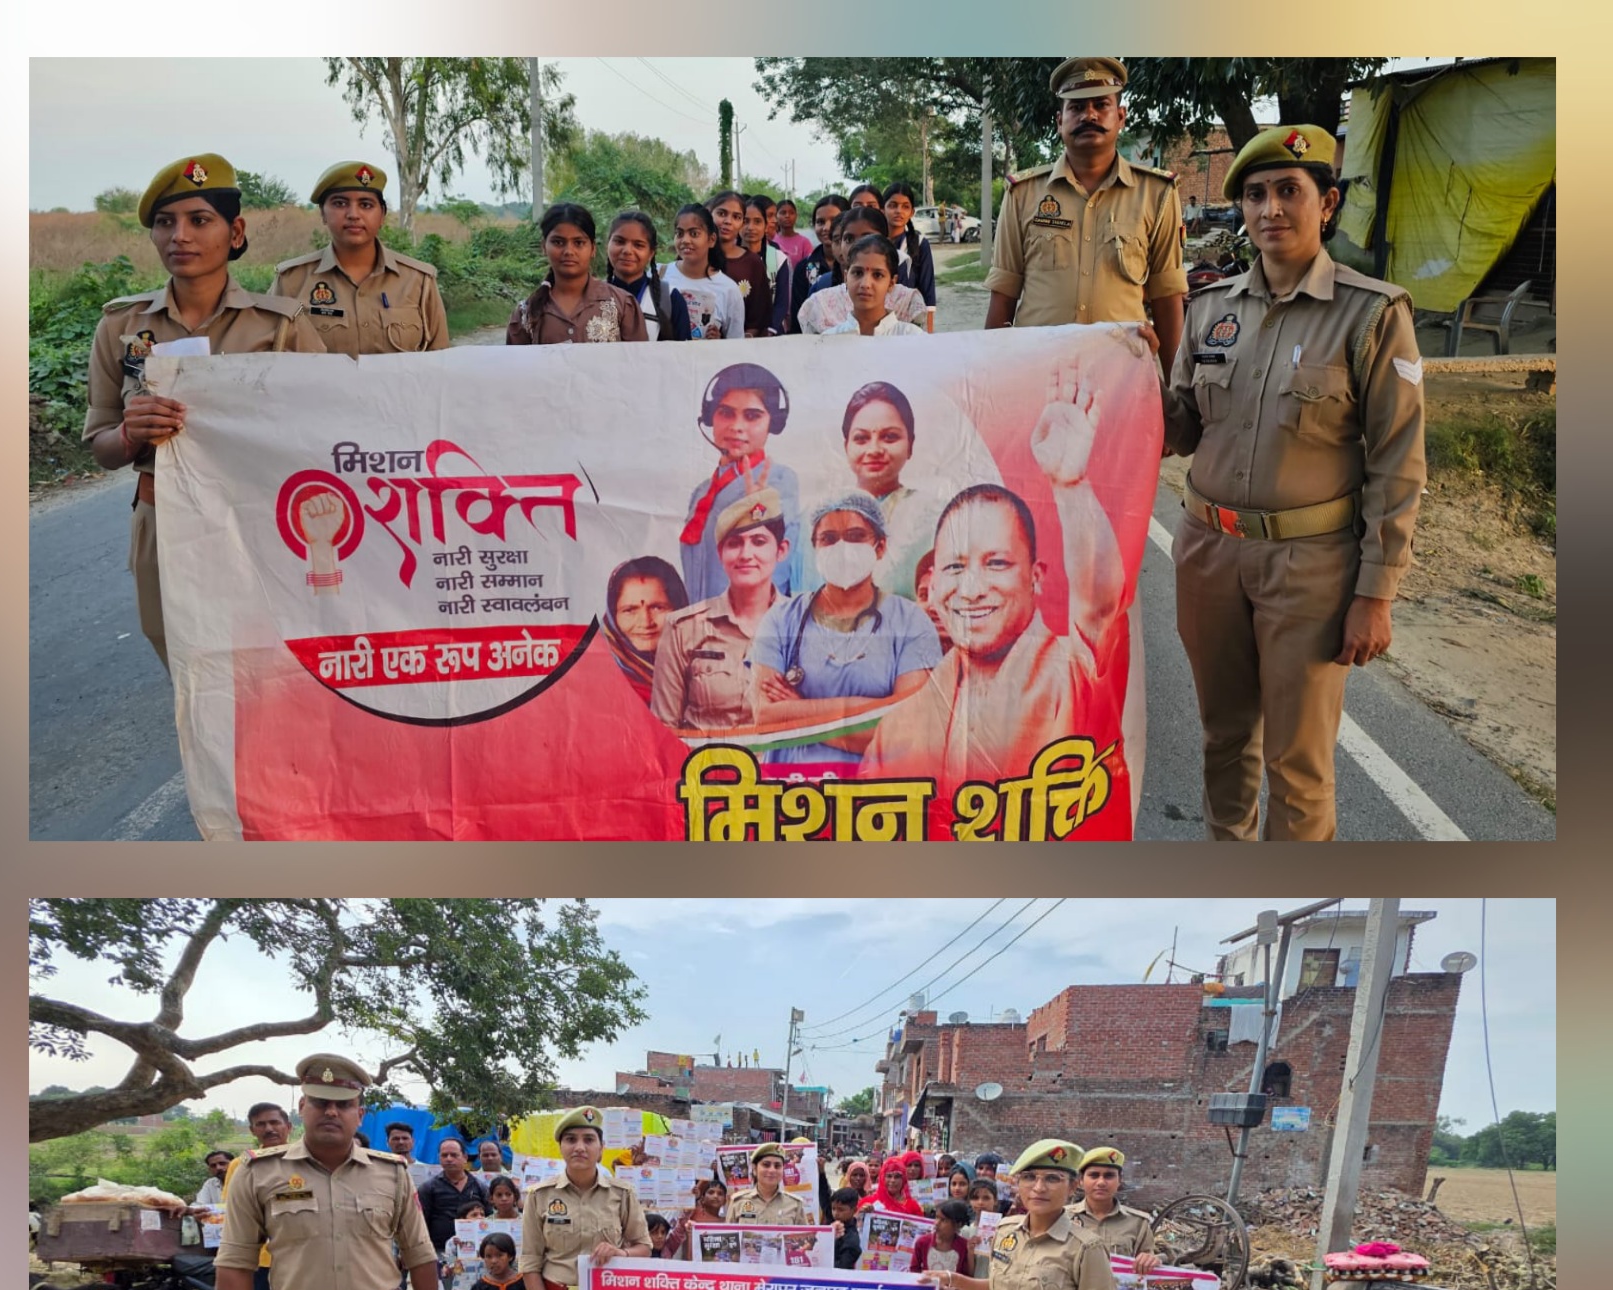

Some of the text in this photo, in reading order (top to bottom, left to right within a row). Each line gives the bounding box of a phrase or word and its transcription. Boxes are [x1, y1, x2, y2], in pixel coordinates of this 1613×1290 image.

[331, 441, 424, 473] मिशन
[364, 439, 584, 589] शक्ति
[433, 546, 528, 571] नारी सुरक्षा
[436, 571, 544, 591] नारी सम्मान
[438, 592, 569, 615] नारी स्वावलंबन
[318, 629, 561, 681] नारी एक रूप अनेक
[678, 735, 1120, 841] मिशन शक्ति
[601, 1270, 640, 1288] मिशन
[643, 1273, 680, 1290] शक्ति
